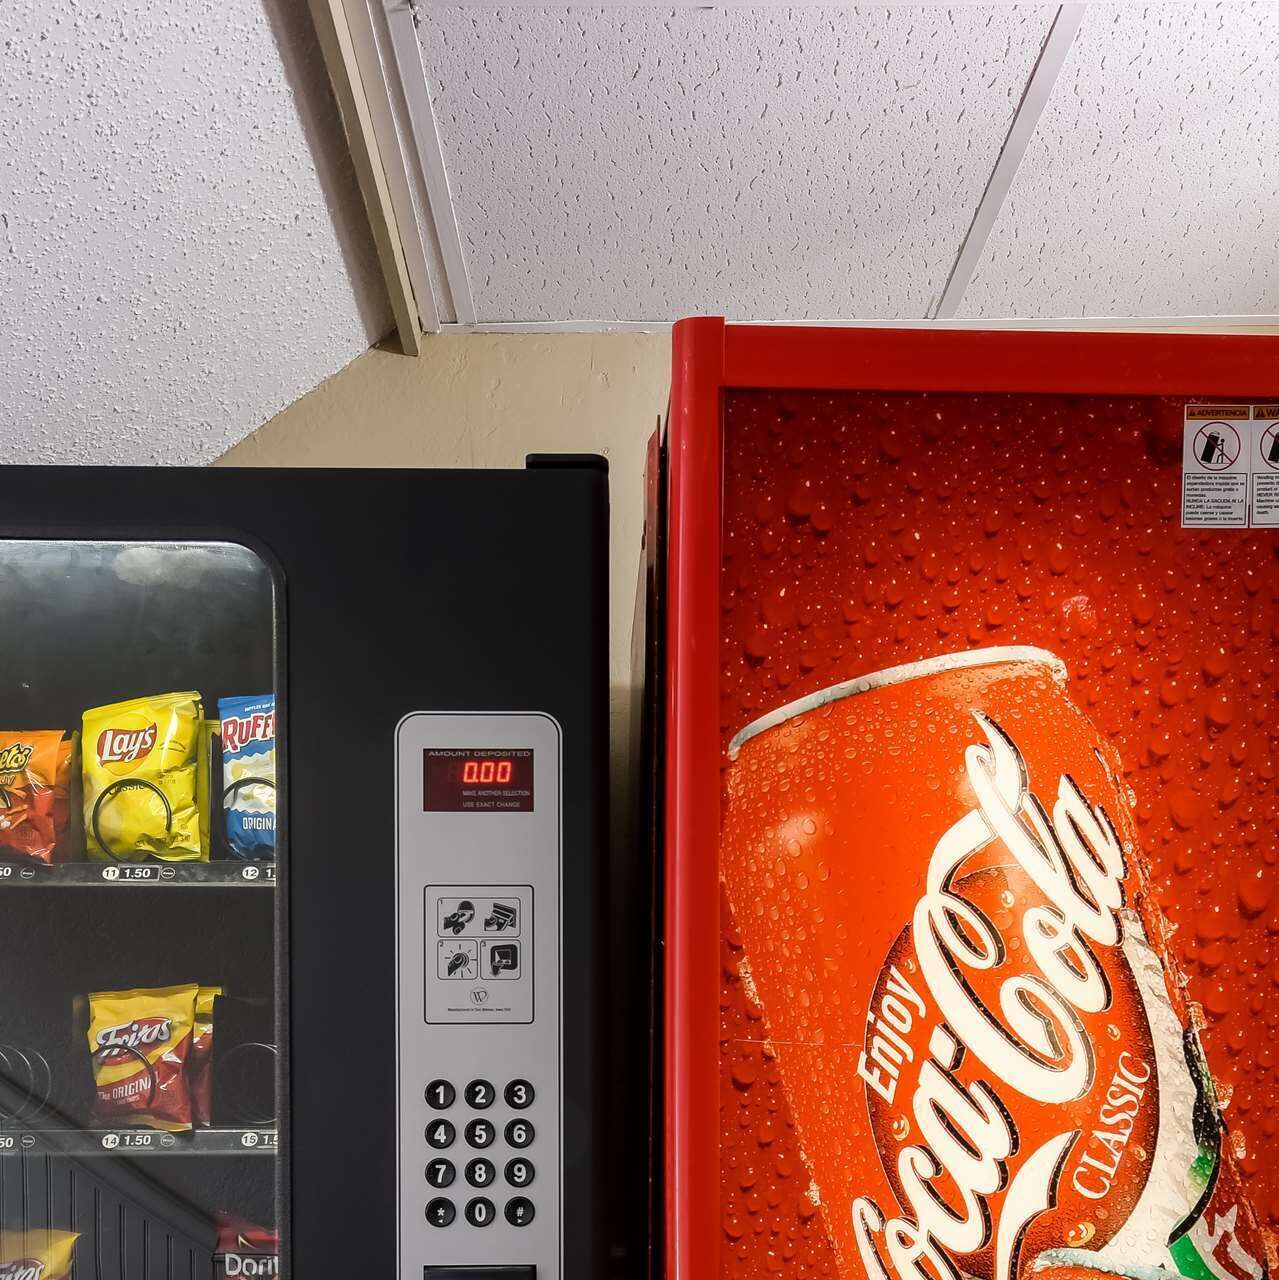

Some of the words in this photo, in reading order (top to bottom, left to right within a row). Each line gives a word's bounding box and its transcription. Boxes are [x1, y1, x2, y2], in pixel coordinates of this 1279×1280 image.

[223, 713, 276, 751] RUFF
[102, 728, 157, 762] Lay's
[463, 762, 512, 783] 0.00
[103, 868, 119, 878] 11
[124, 868, 151, 878] 1.50
[244, 867, 258, 878] 12
[266, 869, 276, 878] 1.
[96, 1018, 173, 1057] Fritos
[858, 965, 927, 1105] Enjoy
[435, 1085, 444, 1104] 1
[474, 1085, 486, 1104] 2
[513, 1085, 526, 1104] 3
[435, 1125, 446, 1143] 4
[474, 1125, 486, 1143] 5
[513, 1125, 526, 1143] 6
[1073, 1052, 1152, 1201] CLASSIC
[104, 1136, 118, 1145] 14
[124, 1135, 151, 1145] 1.50
[243, 1135, 256, 1145] 15
[263, 1135, 278, 1145] 1.5
[435, 1164, 446, 1183] 7
[474, 1164, 486, 1183] 8
[513, 1164, 526, 1183] 9
[475, 1203, 486, 1222] 0
